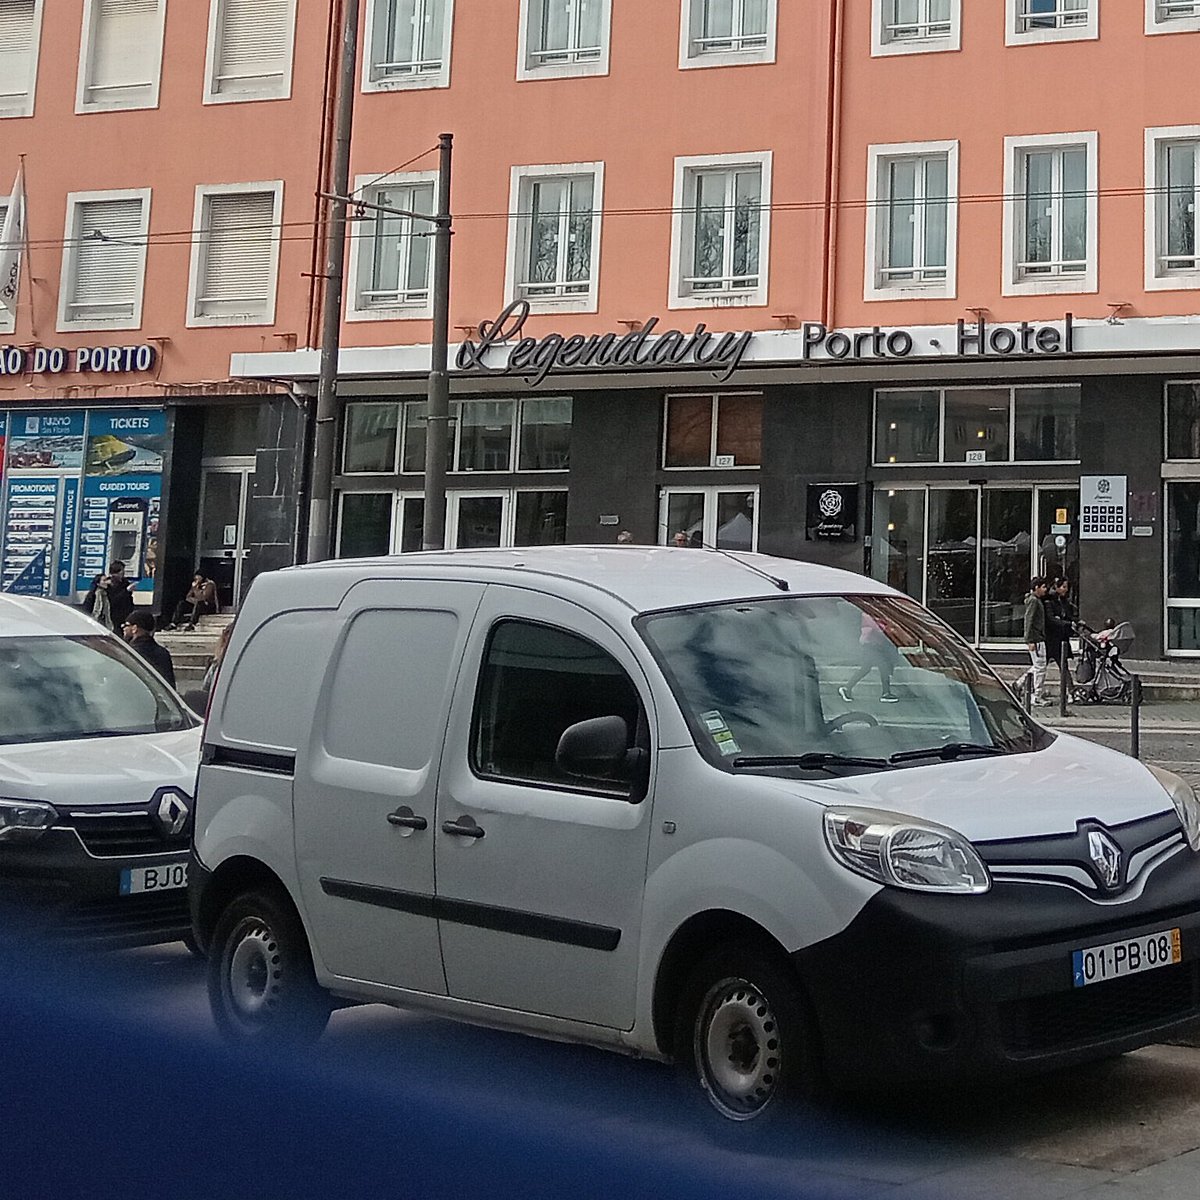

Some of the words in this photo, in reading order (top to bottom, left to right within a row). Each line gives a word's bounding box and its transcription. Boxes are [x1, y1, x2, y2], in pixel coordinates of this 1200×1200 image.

[455, 299, 752, 388] Legendary
[802, 323, 913, 359] Porto
[957, 313, 1073, 356] Hotel
[33, 348, 64, 373] DO
[76, 344, 151, 373] PORTO
[110, 417, 149, 429] TICKETS
[719, 457, 731, 466] 127
[10, 484, 56, 493] PROMOTIONS
[99, 483, 126, 492] GUIDED
[127, 482, 150, 491] TOURS
[65, 489, 75, 525] SERVICE
[62, 527, 71, 563] TOURIST
